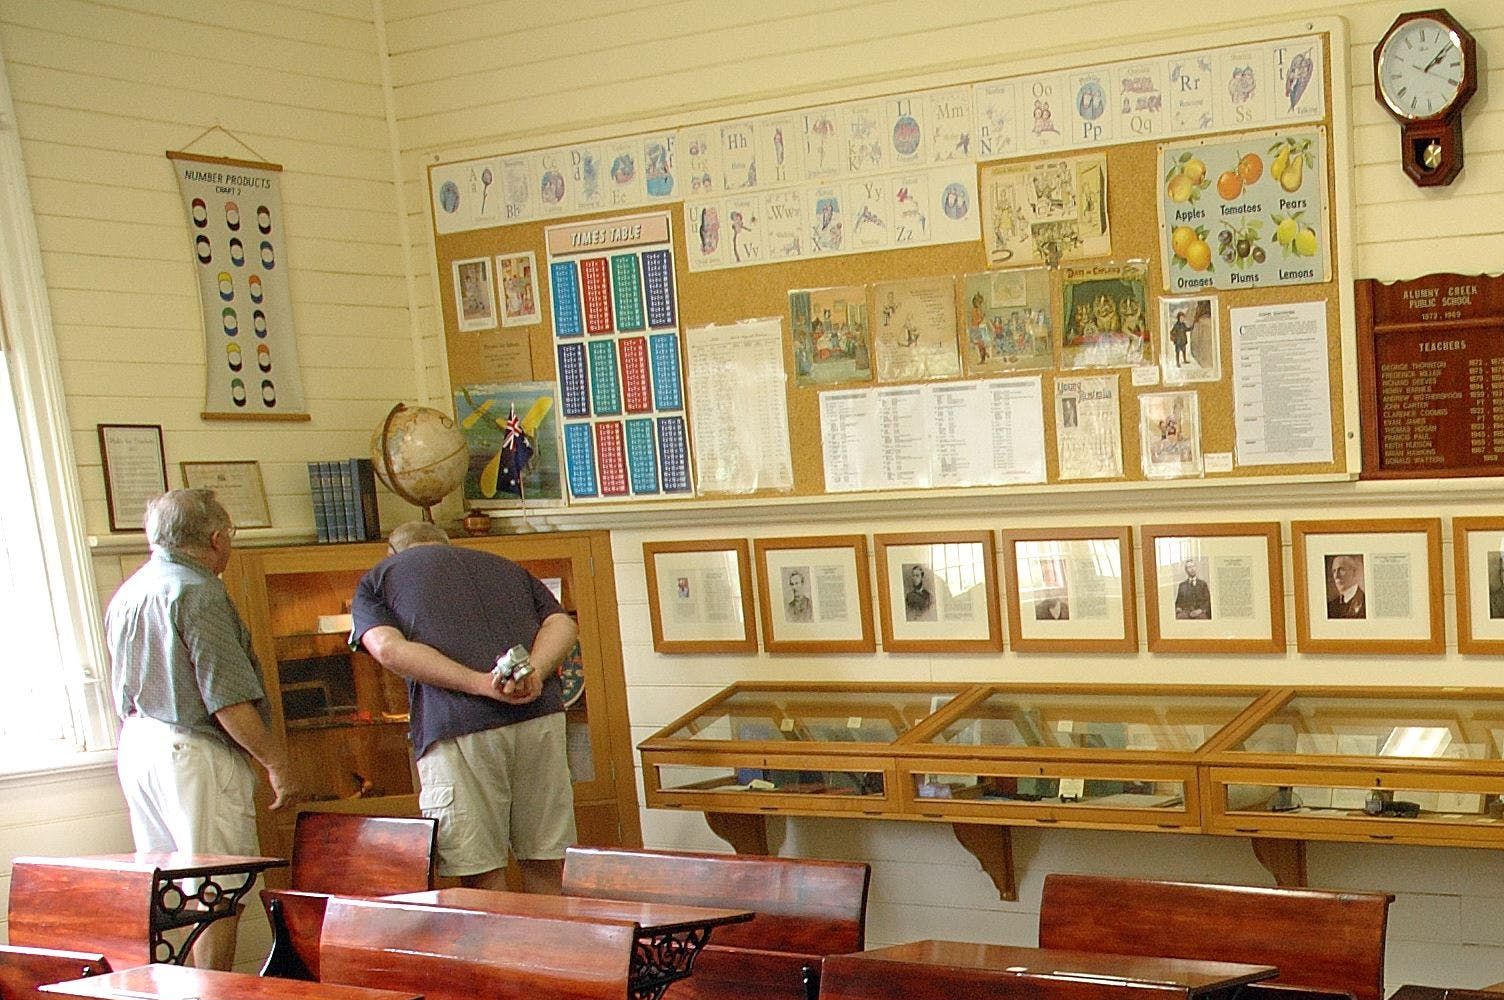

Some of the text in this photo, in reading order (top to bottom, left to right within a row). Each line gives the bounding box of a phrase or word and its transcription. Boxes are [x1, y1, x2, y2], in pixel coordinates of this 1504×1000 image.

[1274, 48, 1286, 66] T
[1033, 80, 1053, 97] Oo
[1181, 75, 1200, 92] Rr
[937, 105, 964, 119] Mm
[1236, 106, 1253, 123] Ss
[982, 124, 989, 137] n
[1083, 121, 1102, 140] Pp
[1131, 117, 1152, 135] Qq
[667, 138, 675, 152] F
[728, 134, 747, 150] Hh
[981, 138, 992, 155] N
[572, 150, 581, 165] D
[185, 170, 270, 189] NUMBER PRODUCTS
[469, 169, 477, 182] A
[574, 168, 580, 182] d
[864, 184, 882, 200] Yy
[506, 203, 520, 219] Bb
[1220, 204, 1262, 216] Tomatoes
[1279, 199, 1307, 210] Pears
[1176, 209, 1205, 222] Apples
[570, 225, 642, 246] TIMES TABLE
[896, 226, 913, 242] Zz
[744, 243, 759, 257] Vv
[1231, 273, 1259, 283] Plums
[1279, 268, 1314, 280] Lemons
[1178, 276, 1213, 288] Oranges
[1403, 285, 1478, 300] ALUMNY CREEK
[1409, 297, 1472, 308] PUBLIC SCHOOL
[1419, 341, 1467, 352] TEACHERS
